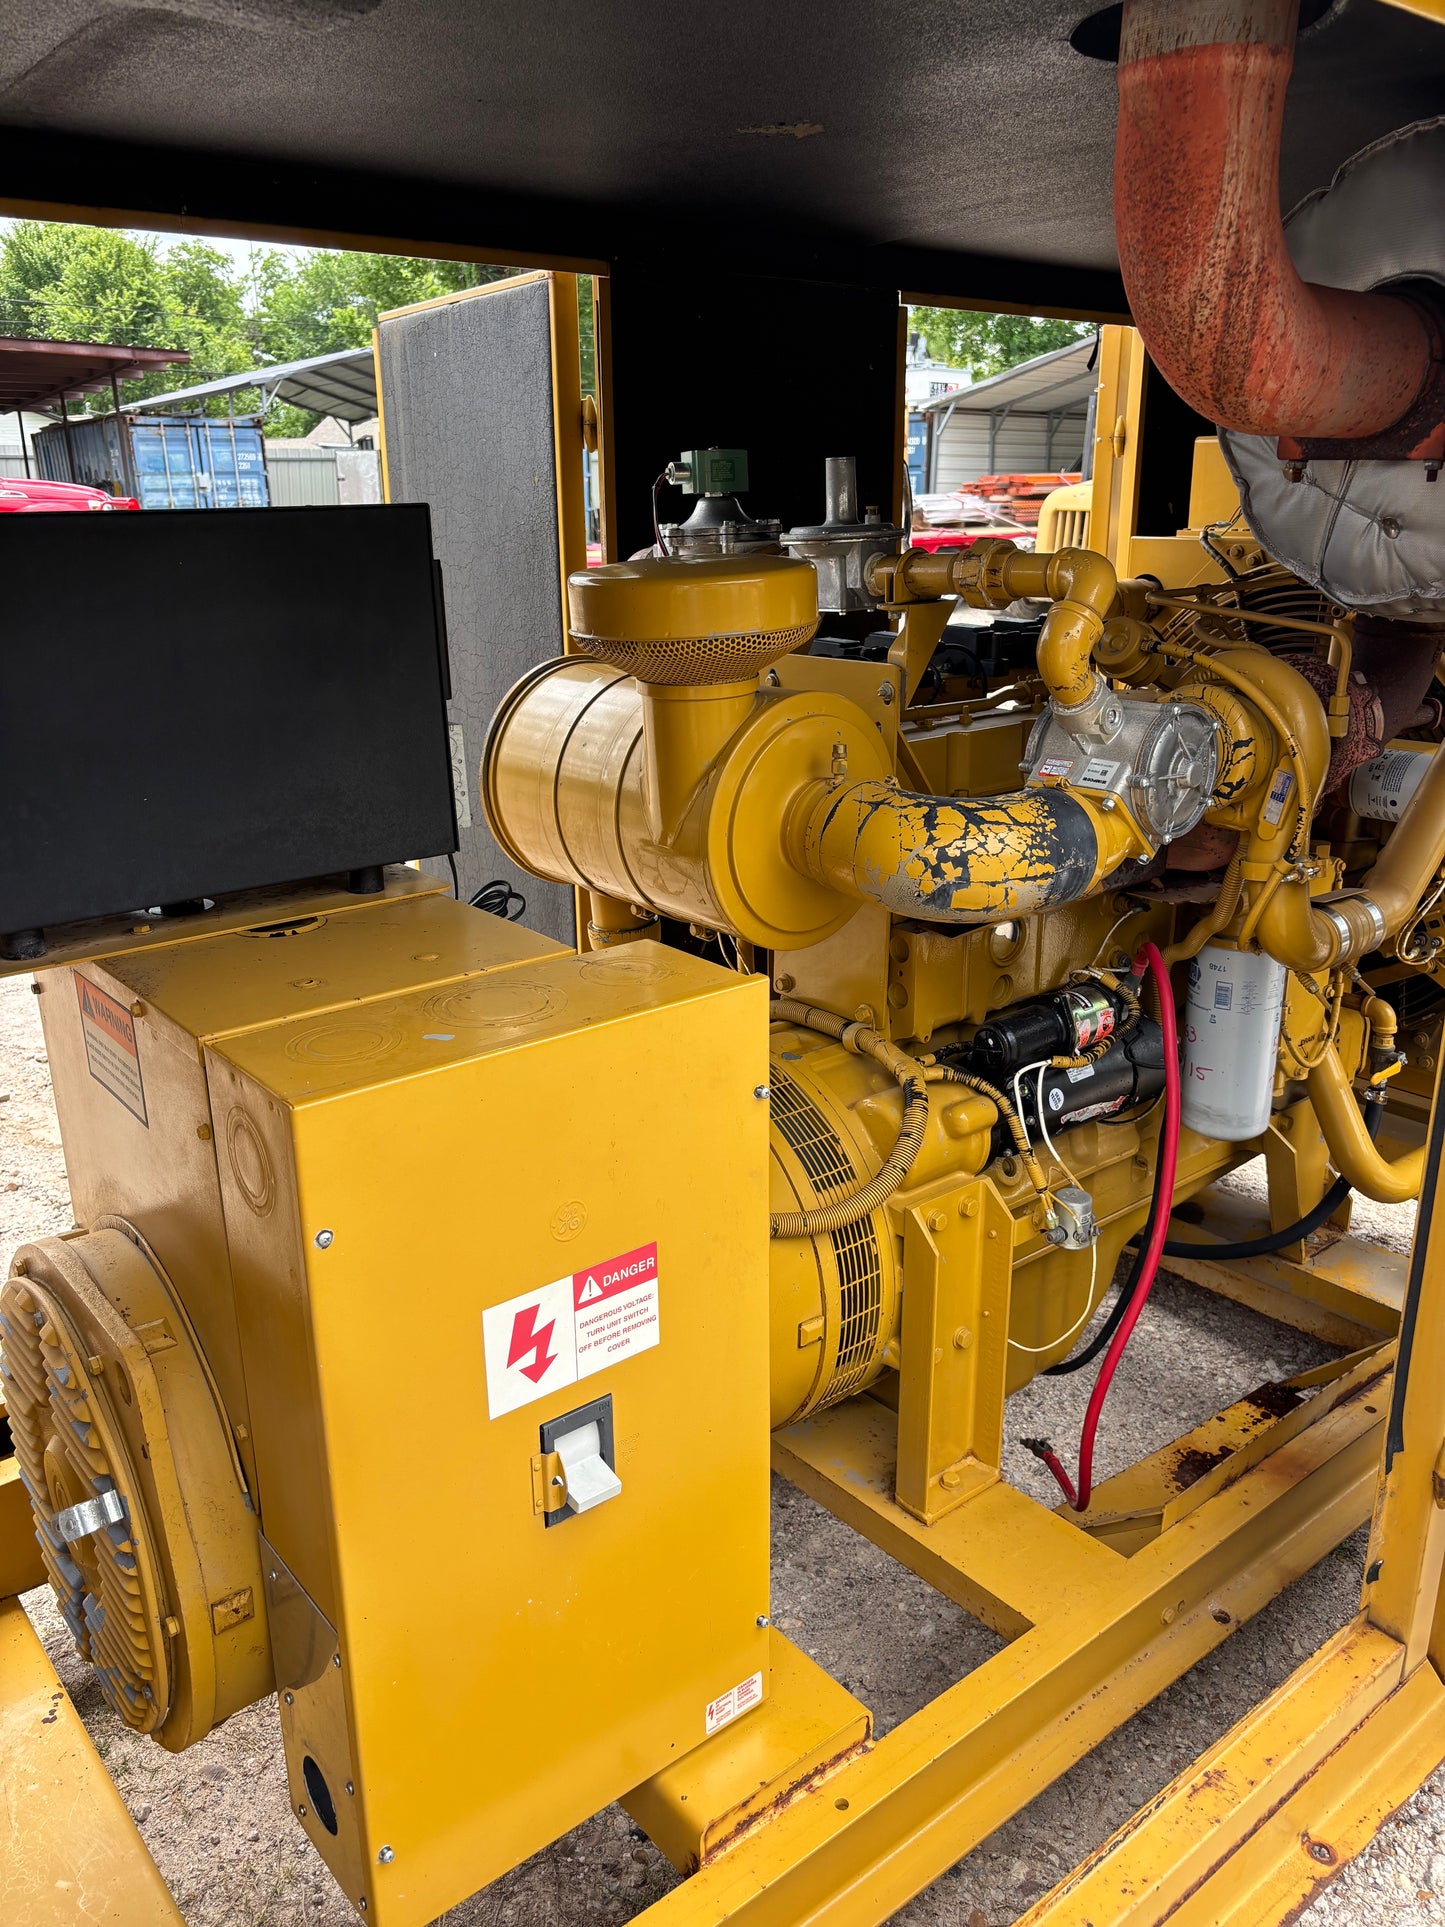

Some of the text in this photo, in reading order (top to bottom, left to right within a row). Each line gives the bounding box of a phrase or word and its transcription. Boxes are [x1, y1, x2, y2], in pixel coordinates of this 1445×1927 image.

[92, 997, 133, 1044] WARNING
[603, 1257, 655, 1287] DANGER
[579, 1306, 622, 1329] DANGEROUS
[586, 1306, 649, 1337] TURN UNIT SWITCH
[578, 1314, 657, 1353] OFF BEFORE REMOVING
[607, 1338, 630, 1353] COVER
